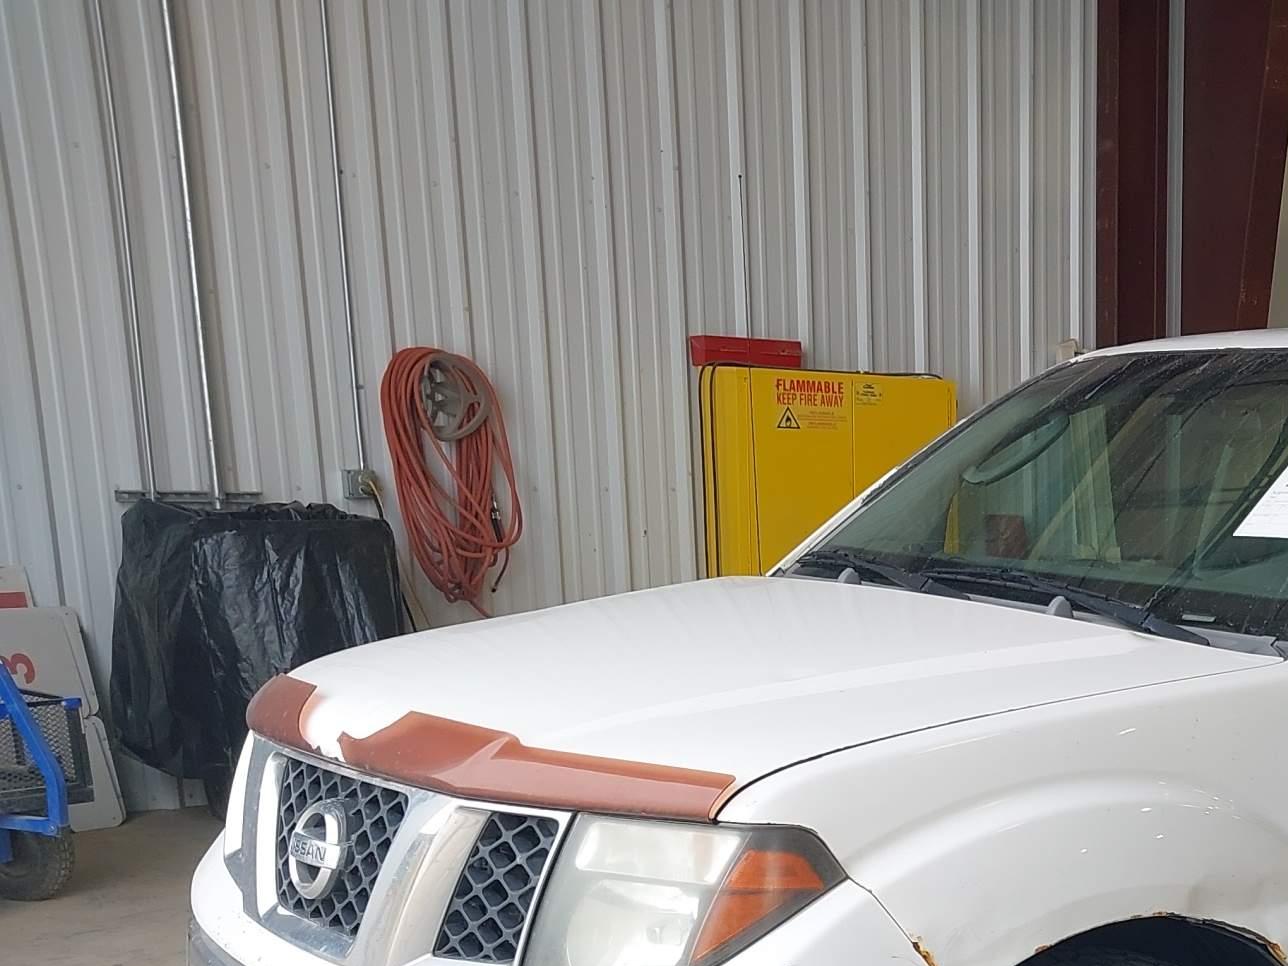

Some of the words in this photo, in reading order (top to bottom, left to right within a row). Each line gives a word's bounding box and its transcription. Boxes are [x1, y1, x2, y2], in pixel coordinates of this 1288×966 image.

[776, 378, 844, 395] FLAMMABLE
[776, 392, 797, 406] KEEP
[800, 393, 818, 407] FIRE
[820, 394, 844, 408] AWAY
